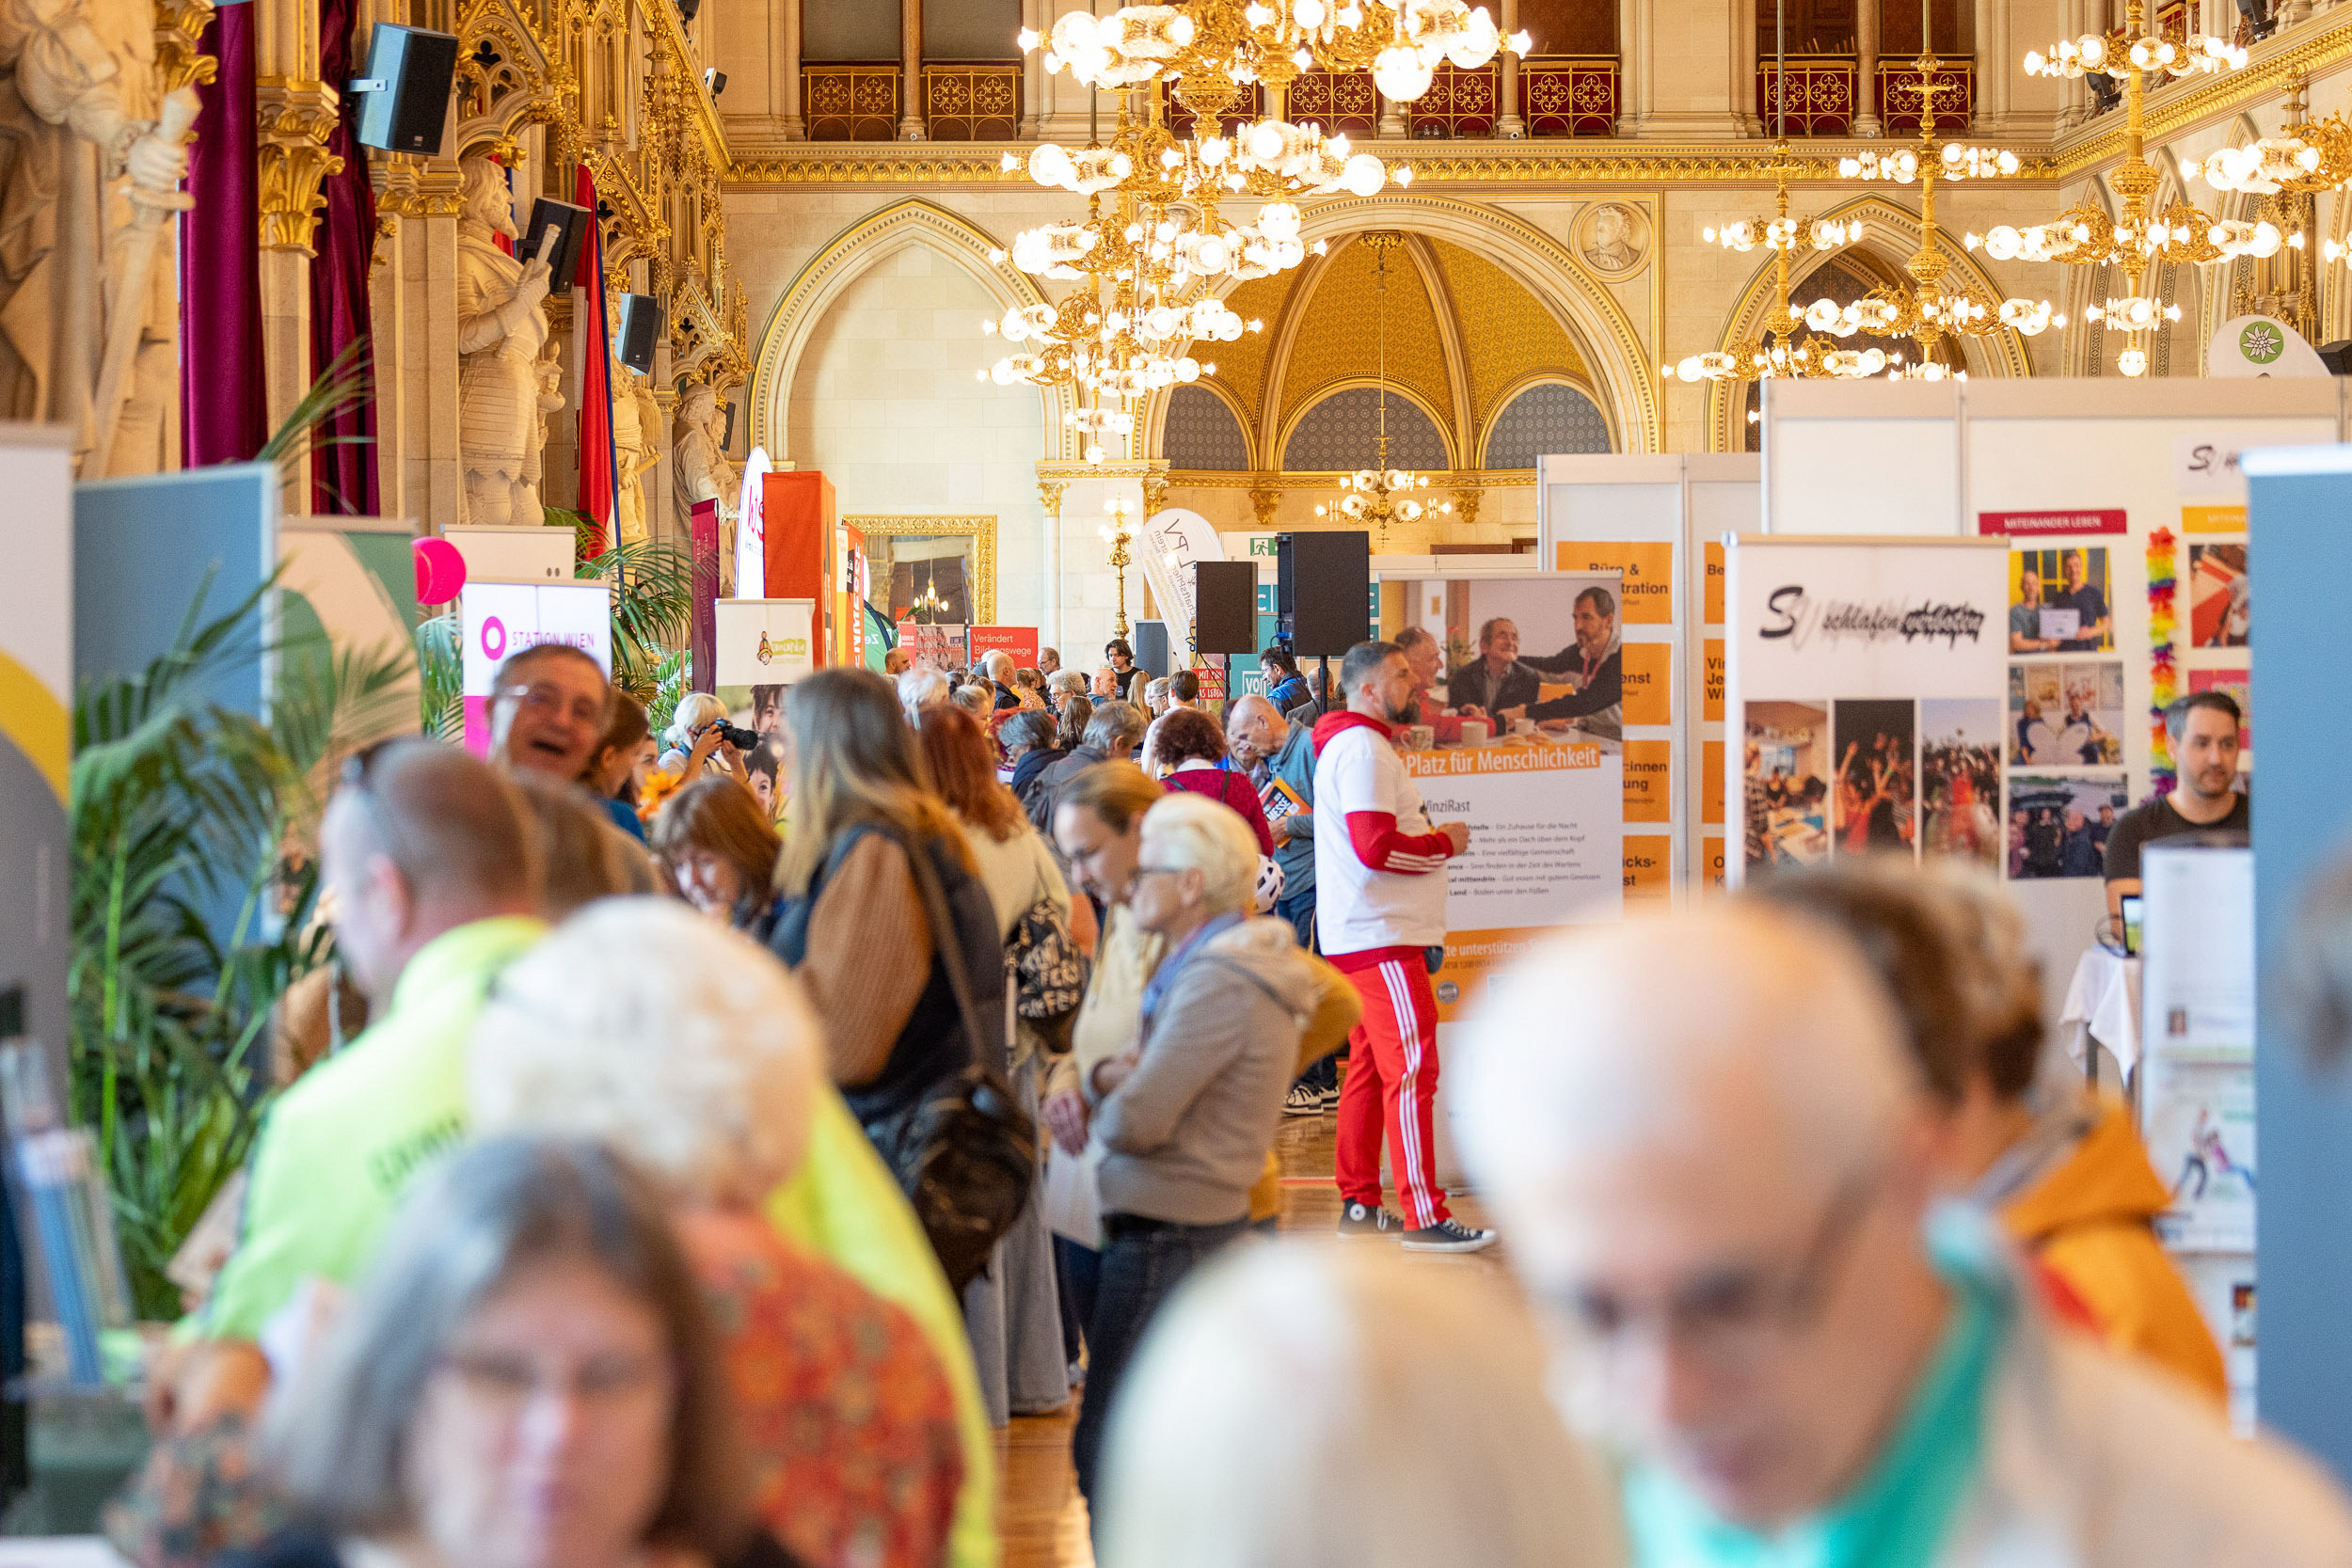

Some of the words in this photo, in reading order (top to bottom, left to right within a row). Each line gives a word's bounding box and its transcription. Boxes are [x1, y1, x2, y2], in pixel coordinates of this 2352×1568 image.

[2004, 517, 2070, 530] MITEINANDER
[2071, 515, 2102, 528] LEBEN
[1629, 562, 1640, 576] &
[1707, 564, 1724, 576] Be
[1621, 582, 1668, 594] tration
[512, 631, 560, 647] STATION
[564, 632, 595, 648] WIEN
[973, 633, 1013, 643] Verändert
[1620, 672, 1651, 685] enst
[1406, 753, 1447, 775] Platz
[1450, 751, 1472, 773] für
[1477, 745, 1597, 772] Menschlichkeit
[1623, 779, 1648, 792] ung
[1265, 796, 1292, 821] MESSE
[1623, 855, 1657, 868] cks-
[1459, 940, 1529, 957] unterstützen
